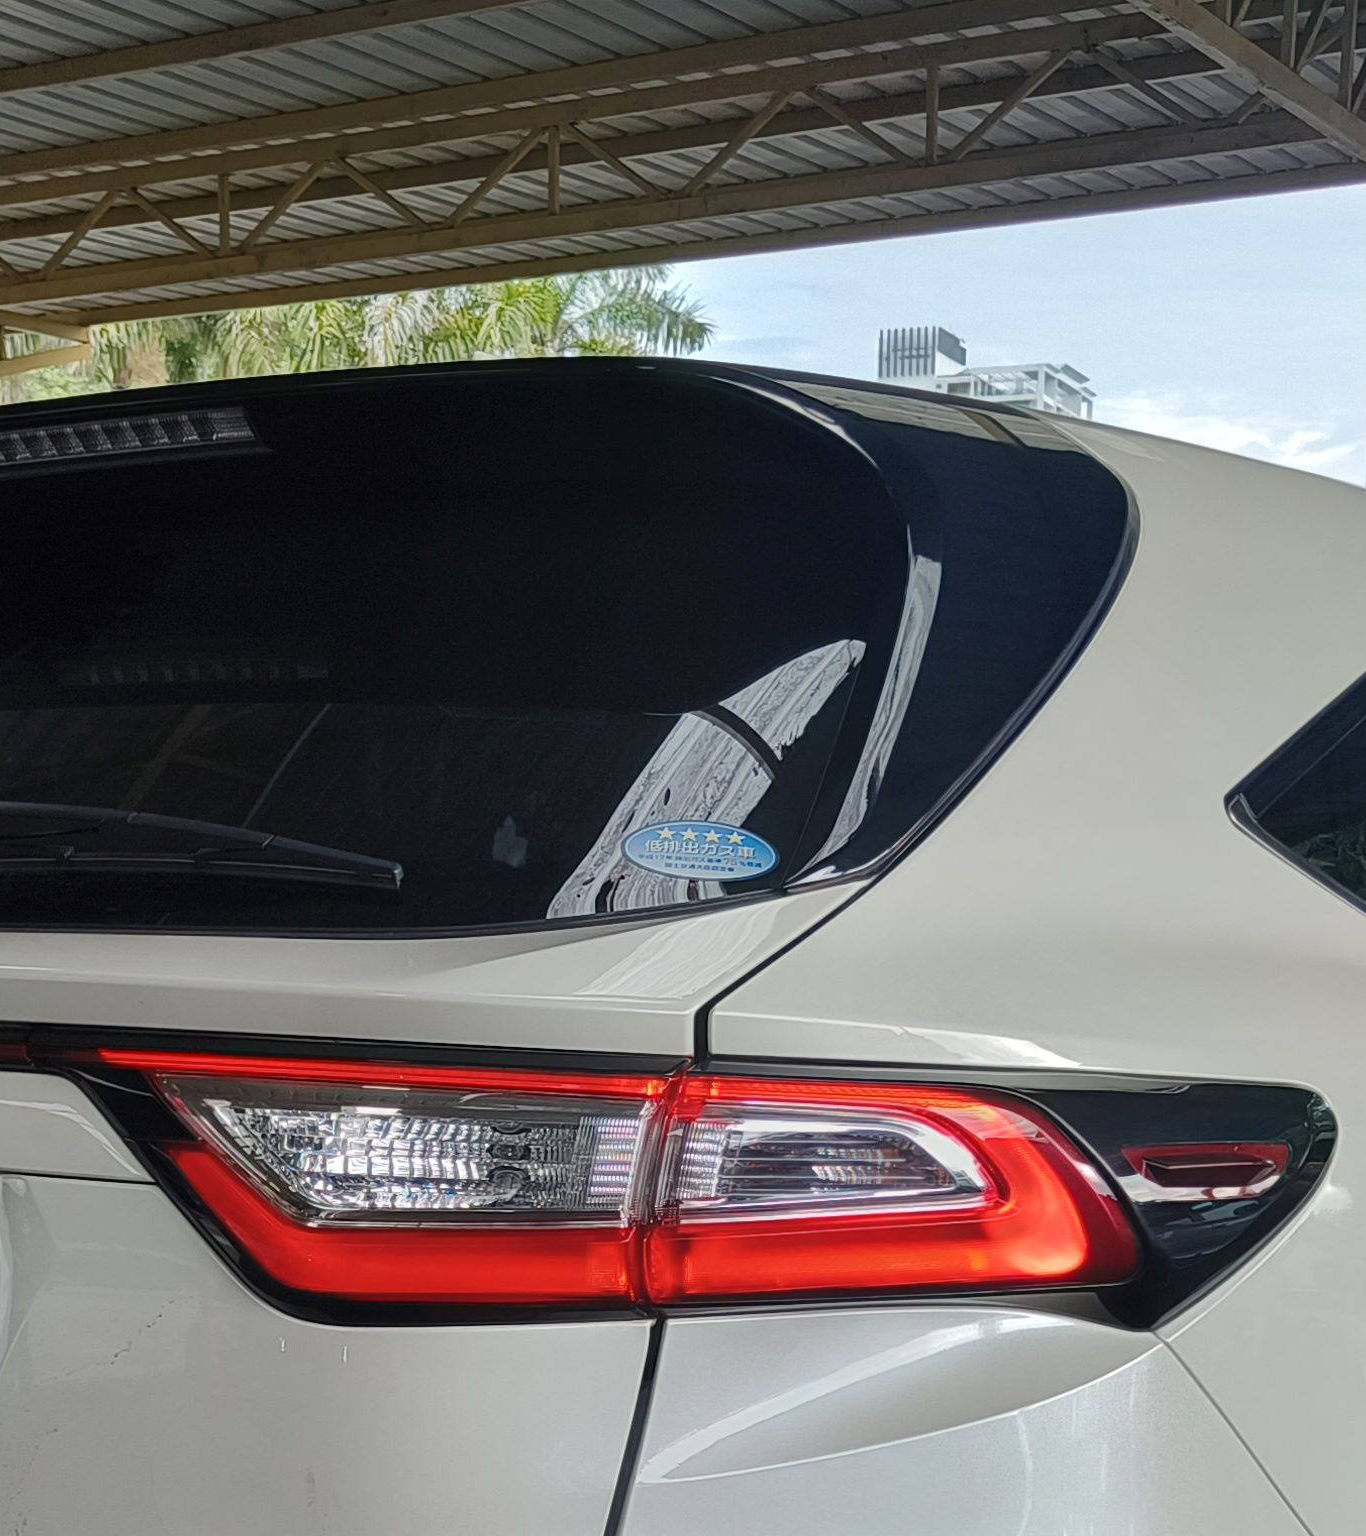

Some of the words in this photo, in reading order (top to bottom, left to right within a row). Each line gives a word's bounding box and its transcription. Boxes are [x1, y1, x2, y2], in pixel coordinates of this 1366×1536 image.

[645, 840, 755, 859] 低排出ガス車
